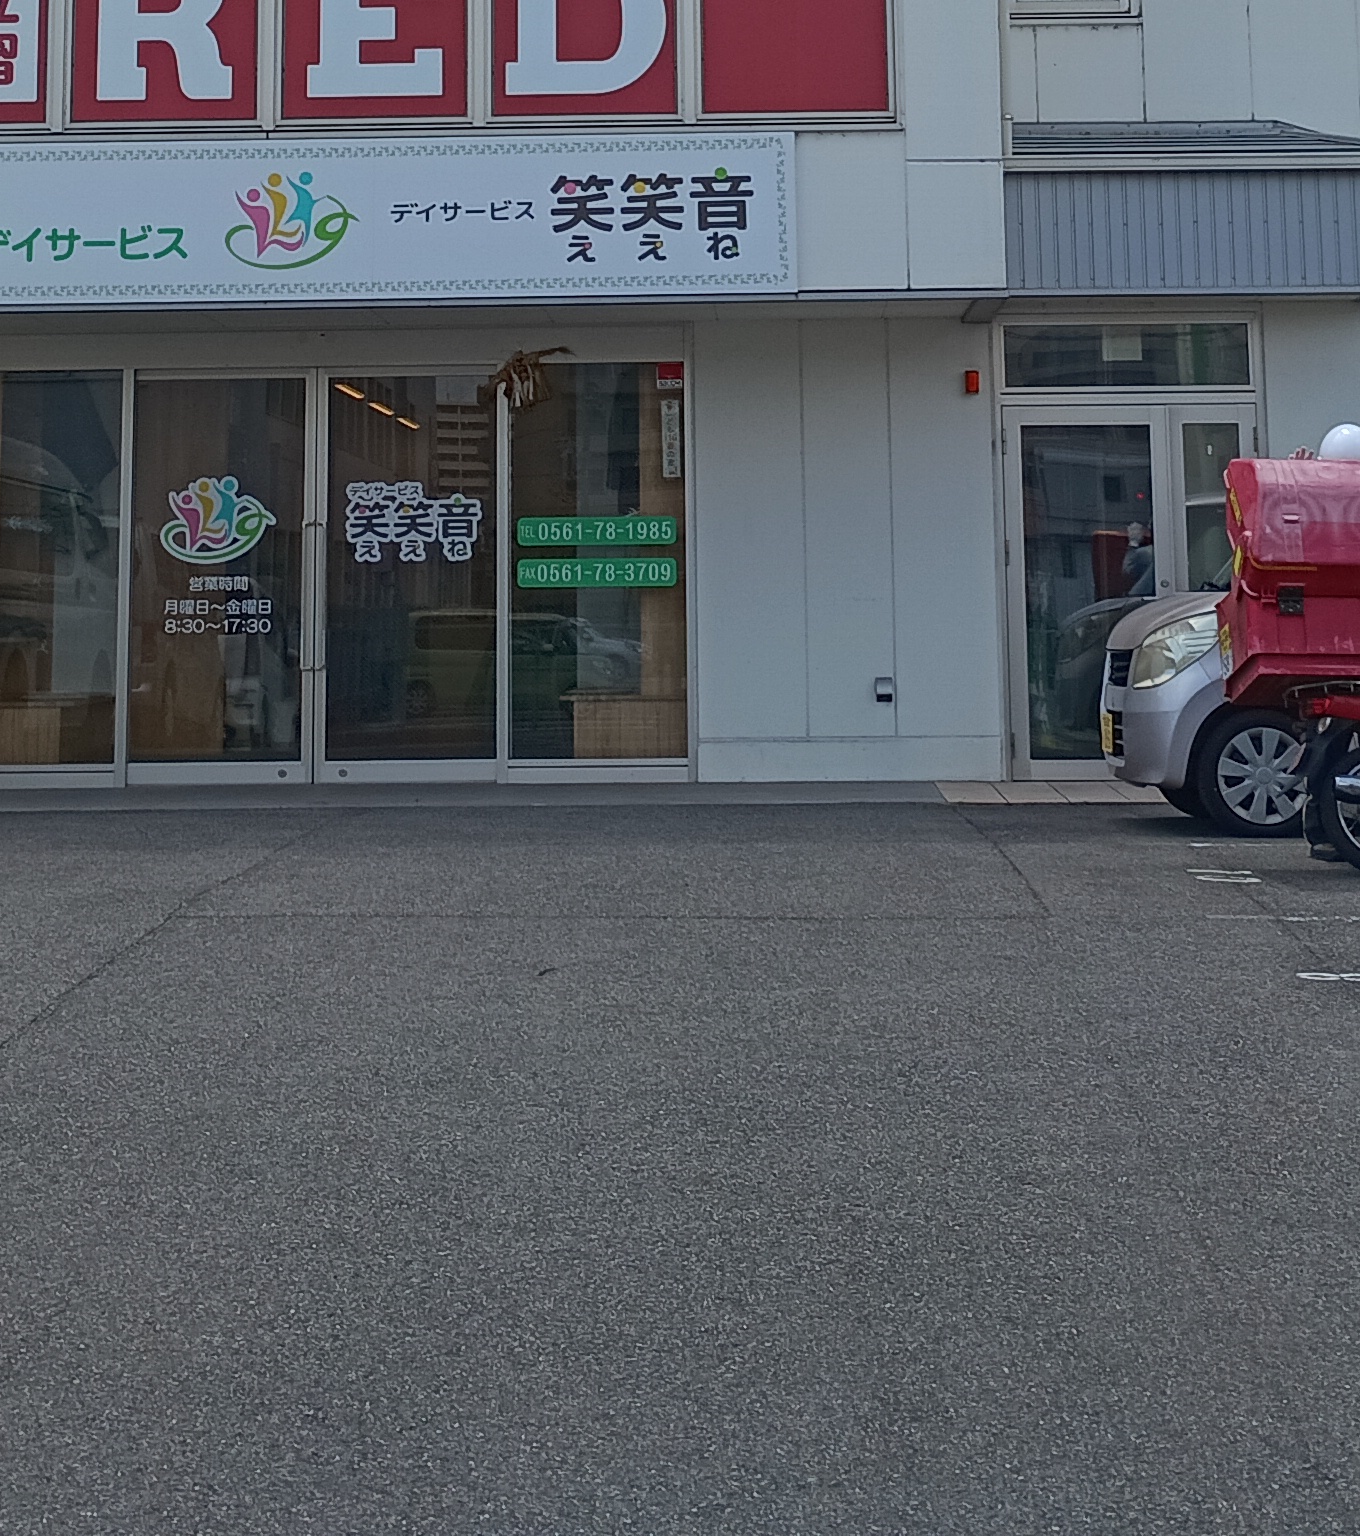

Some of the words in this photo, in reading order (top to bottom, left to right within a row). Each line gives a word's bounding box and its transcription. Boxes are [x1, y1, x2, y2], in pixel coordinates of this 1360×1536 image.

[550, 167, 754, 232] 笑笑音
[390, 200, 535, 223] デイサービス
[349, 484, 421, 498] デイサービス
[349, 497, 479, 540] 笑笑音
[520, 525, 535, 538] TEL
[538, 522, 672, 540] 0561-78-1985
[520, 567, 536, 579] FAX
[537, 563, 671, 582] 0561-78-3709
[189, 576, 249, 591] 営業時間
